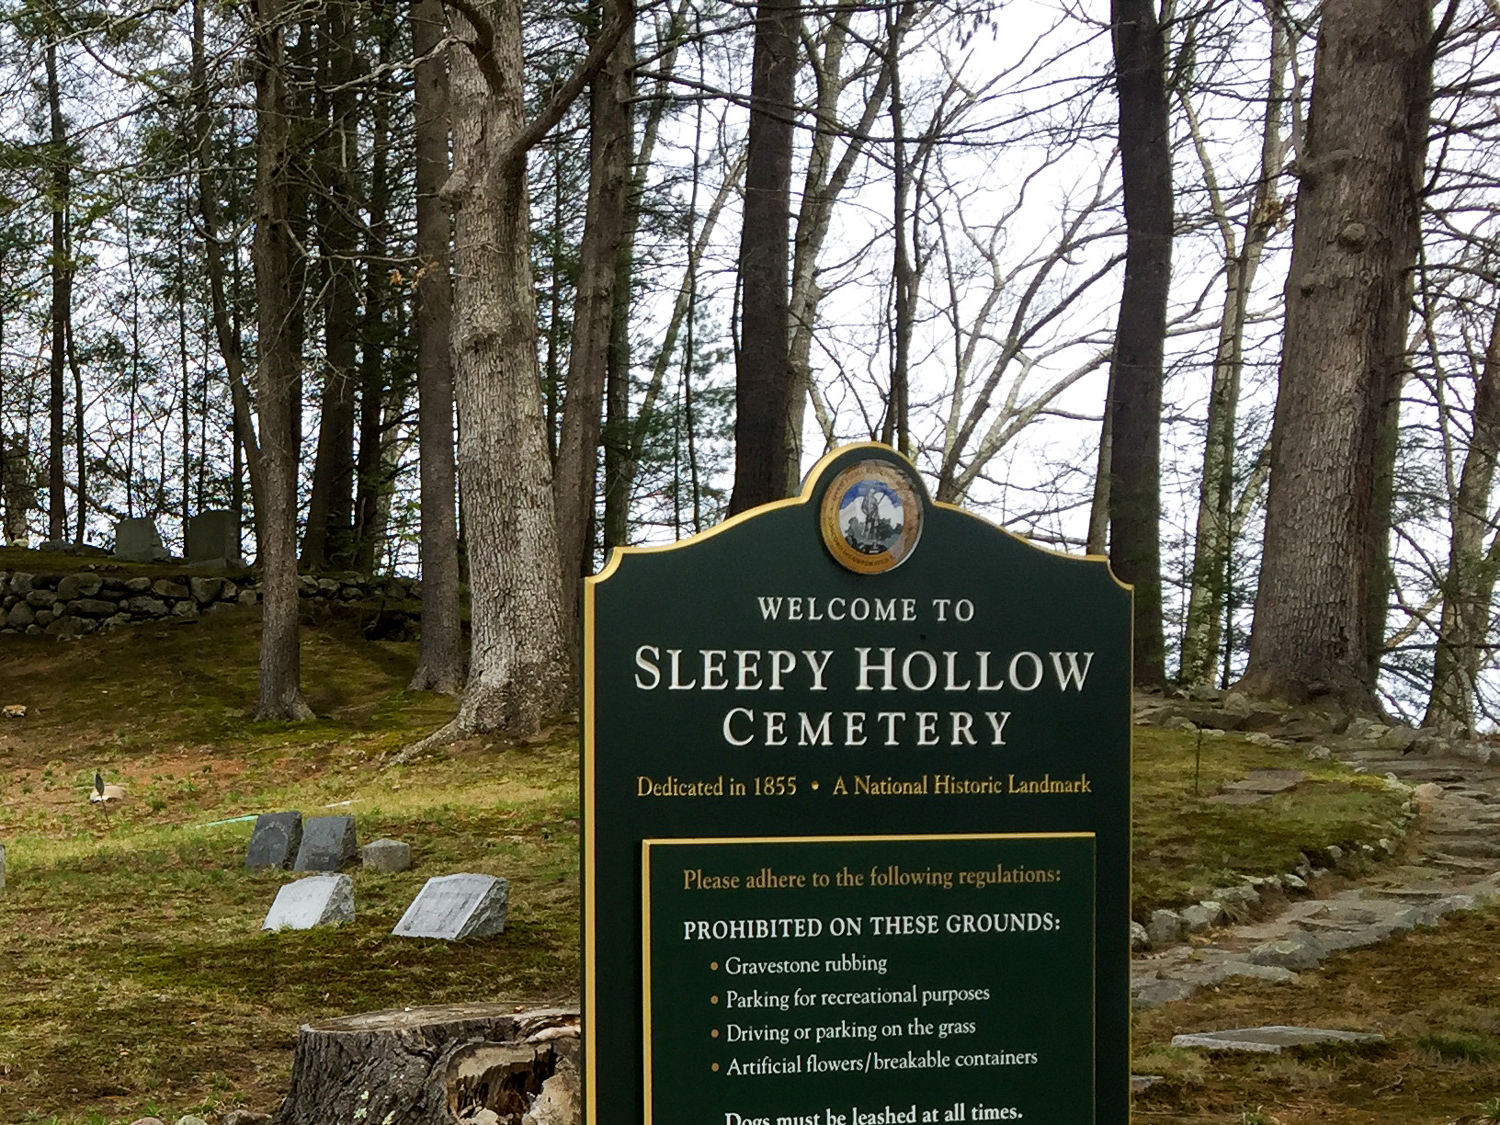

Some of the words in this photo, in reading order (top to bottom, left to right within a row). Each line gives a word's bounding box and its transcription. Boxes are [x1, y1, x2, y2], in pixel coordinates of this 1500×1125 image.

[757, 596, 918, 622] WELCOME
[931, 598, 975, 623] TO
[634, 644, 835, 692] SLEEPY
[853, 646, 1095, 693] HOLLOW
[722, 706, 1012, 747] CEMETERY
[636, 775, 724, 797] Dedicated
[729, 777, 747, 797] in
[754, 775, 797, 796] 1855
[832, 775, 849, 796] A
[853, 774, 929, 796] National
[933, 774, 1003, 795] Historic
[1008, 773, 1092, 794] Landmark
[683, 868, 741, 890] Please
[745, 867, 806, 889] adhere
[811, 869, 831, 889] to
[835, 866, 864, 887] the
[869, 865, 954, 890] following
[958, 863, 1061, 889] regulations:
[683, 917, 823, 941] PROHIBITED
[829, 916, 863, 937] ON
[868, 914, 940, 936] THESE
[945, 911, 1061, 934] GROUNDS:
[724, 955, 821, 976] Gravestone
[824, 952, 888, 976] rubbing
[726, 988, 791, 1012] Parking
[793, 987, 818, 1007] for
[820, 983, 919, 1006] recreational
[921, 988, 991, 1007] purposes
[726, 1023, 791, 1045] Driving
[793, 1027, 812, 1041] or
[815, 1019, 878, 1044] parking
[880, 1024, 904, 1037] on
[907, 1016, 935, 1036] the
[937, 1021, 977, 1040] grass
[726, 1054, 803, 1077] Artificial
[806, 1049, 951, 1076] flowers/breakable
[954, 1049, 1039, 1068] containers
[921, 1107, 940, 1124] at
[943, 1102, 966, 1123] all
[970, 1102, 1024, 1122] times.
